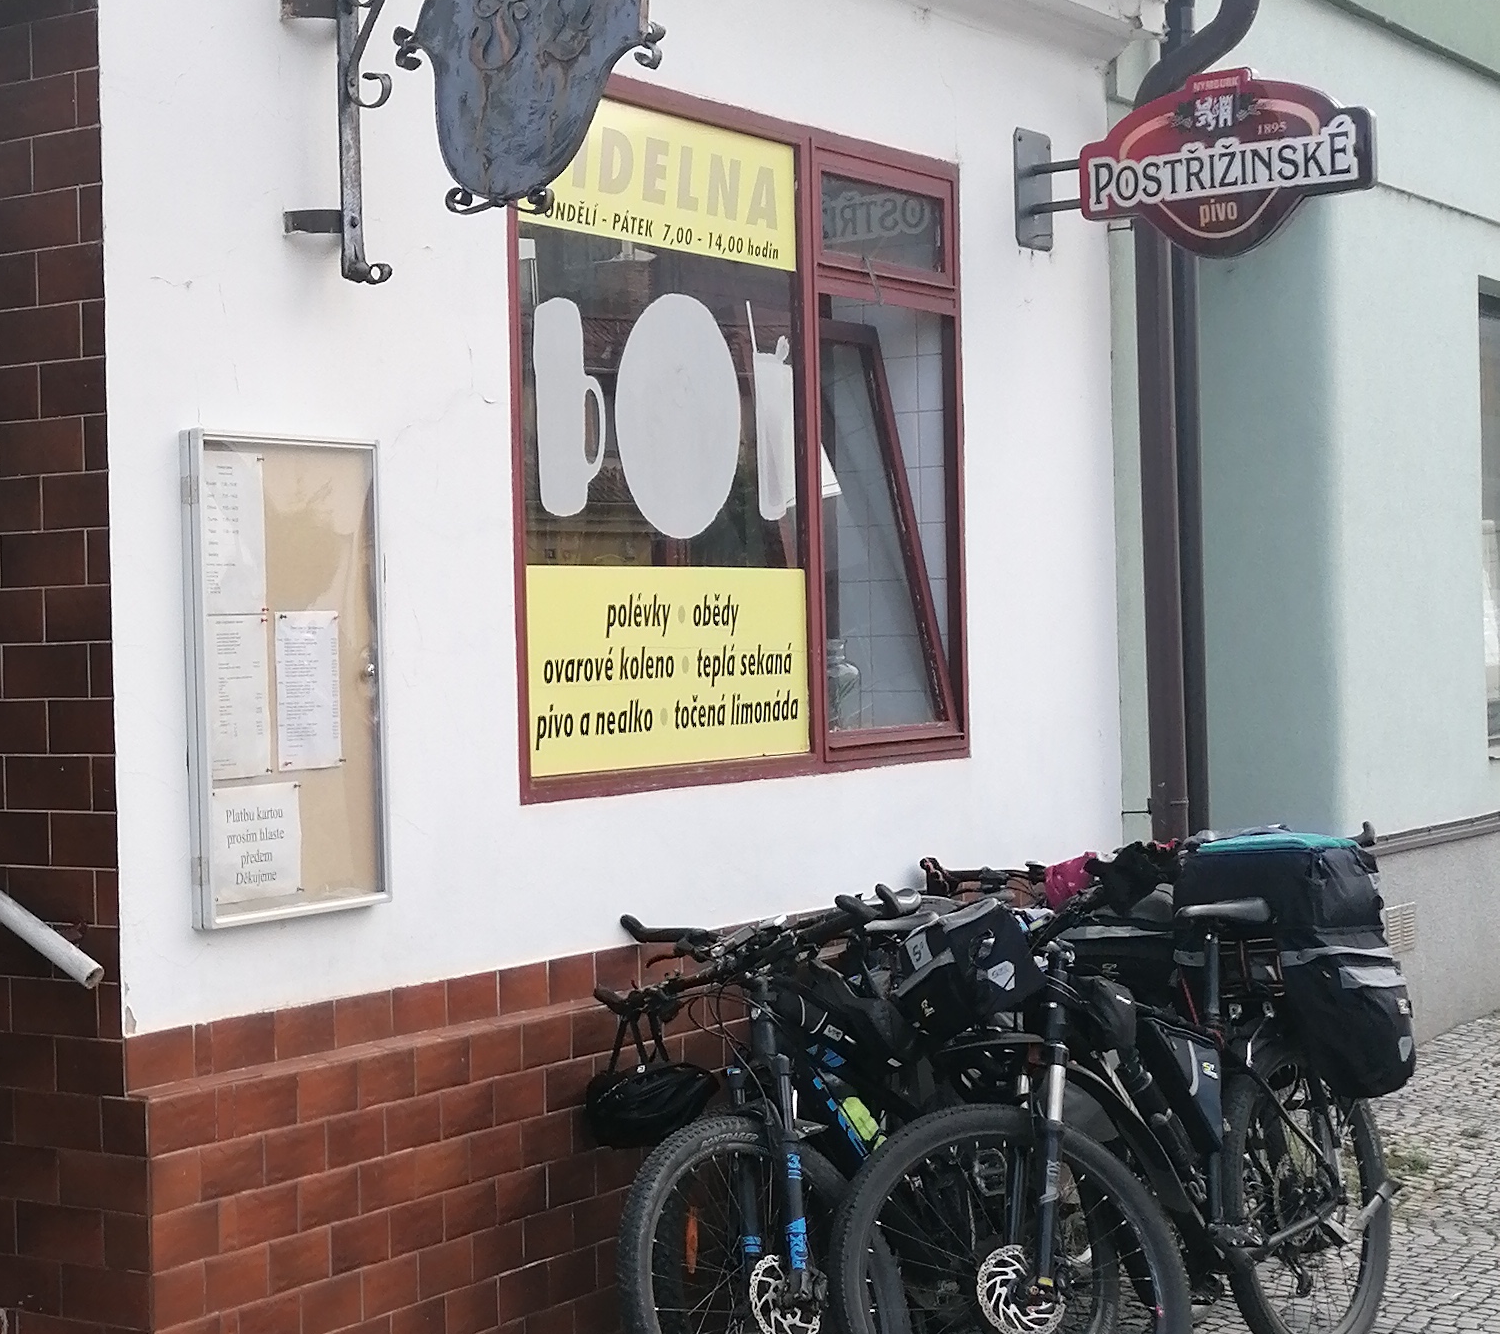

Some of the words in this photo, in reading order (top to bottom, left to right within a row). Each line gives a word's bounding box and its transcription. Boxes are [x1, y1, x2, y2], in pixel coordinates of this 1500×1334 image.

[1257, 122, 1287, 135] 1895
[571, 126, 779, 231] IDELNA
[1093, 118, 1352, 205] POSTŘIŽINSKÉ
[544, 200, 598, 227] ONDĚLÍ
[612, 210, 653, 238] PÁTEK
[663, 223, 693, 245] 7,00
[708, 232, 743, 255] 14,00
[747, 237, 779, 259] hodin
[605, 592, 671, 639] polévky
[692, 592, 740, 637] obědy
[543, 645, 614, 685] ovarové
[618, 645, 675, 681] koleno
[696, 642, 736, 688] teplá
[740, 641, 793, 676] sekaná
[535, 703, 574, 751] pivo
[579, 714, 590, 737] a
[595, 698, 654, 736] nealko
[674, 693, 726, 730] točená
[730, 688, 800, 726] limonáda
[226, 808, 255, 823] Platbu
[256, 806, 284, 821] kartou
[235, 869, 278, 887] Děkujeme
[240, 849, 274, 869] předem
